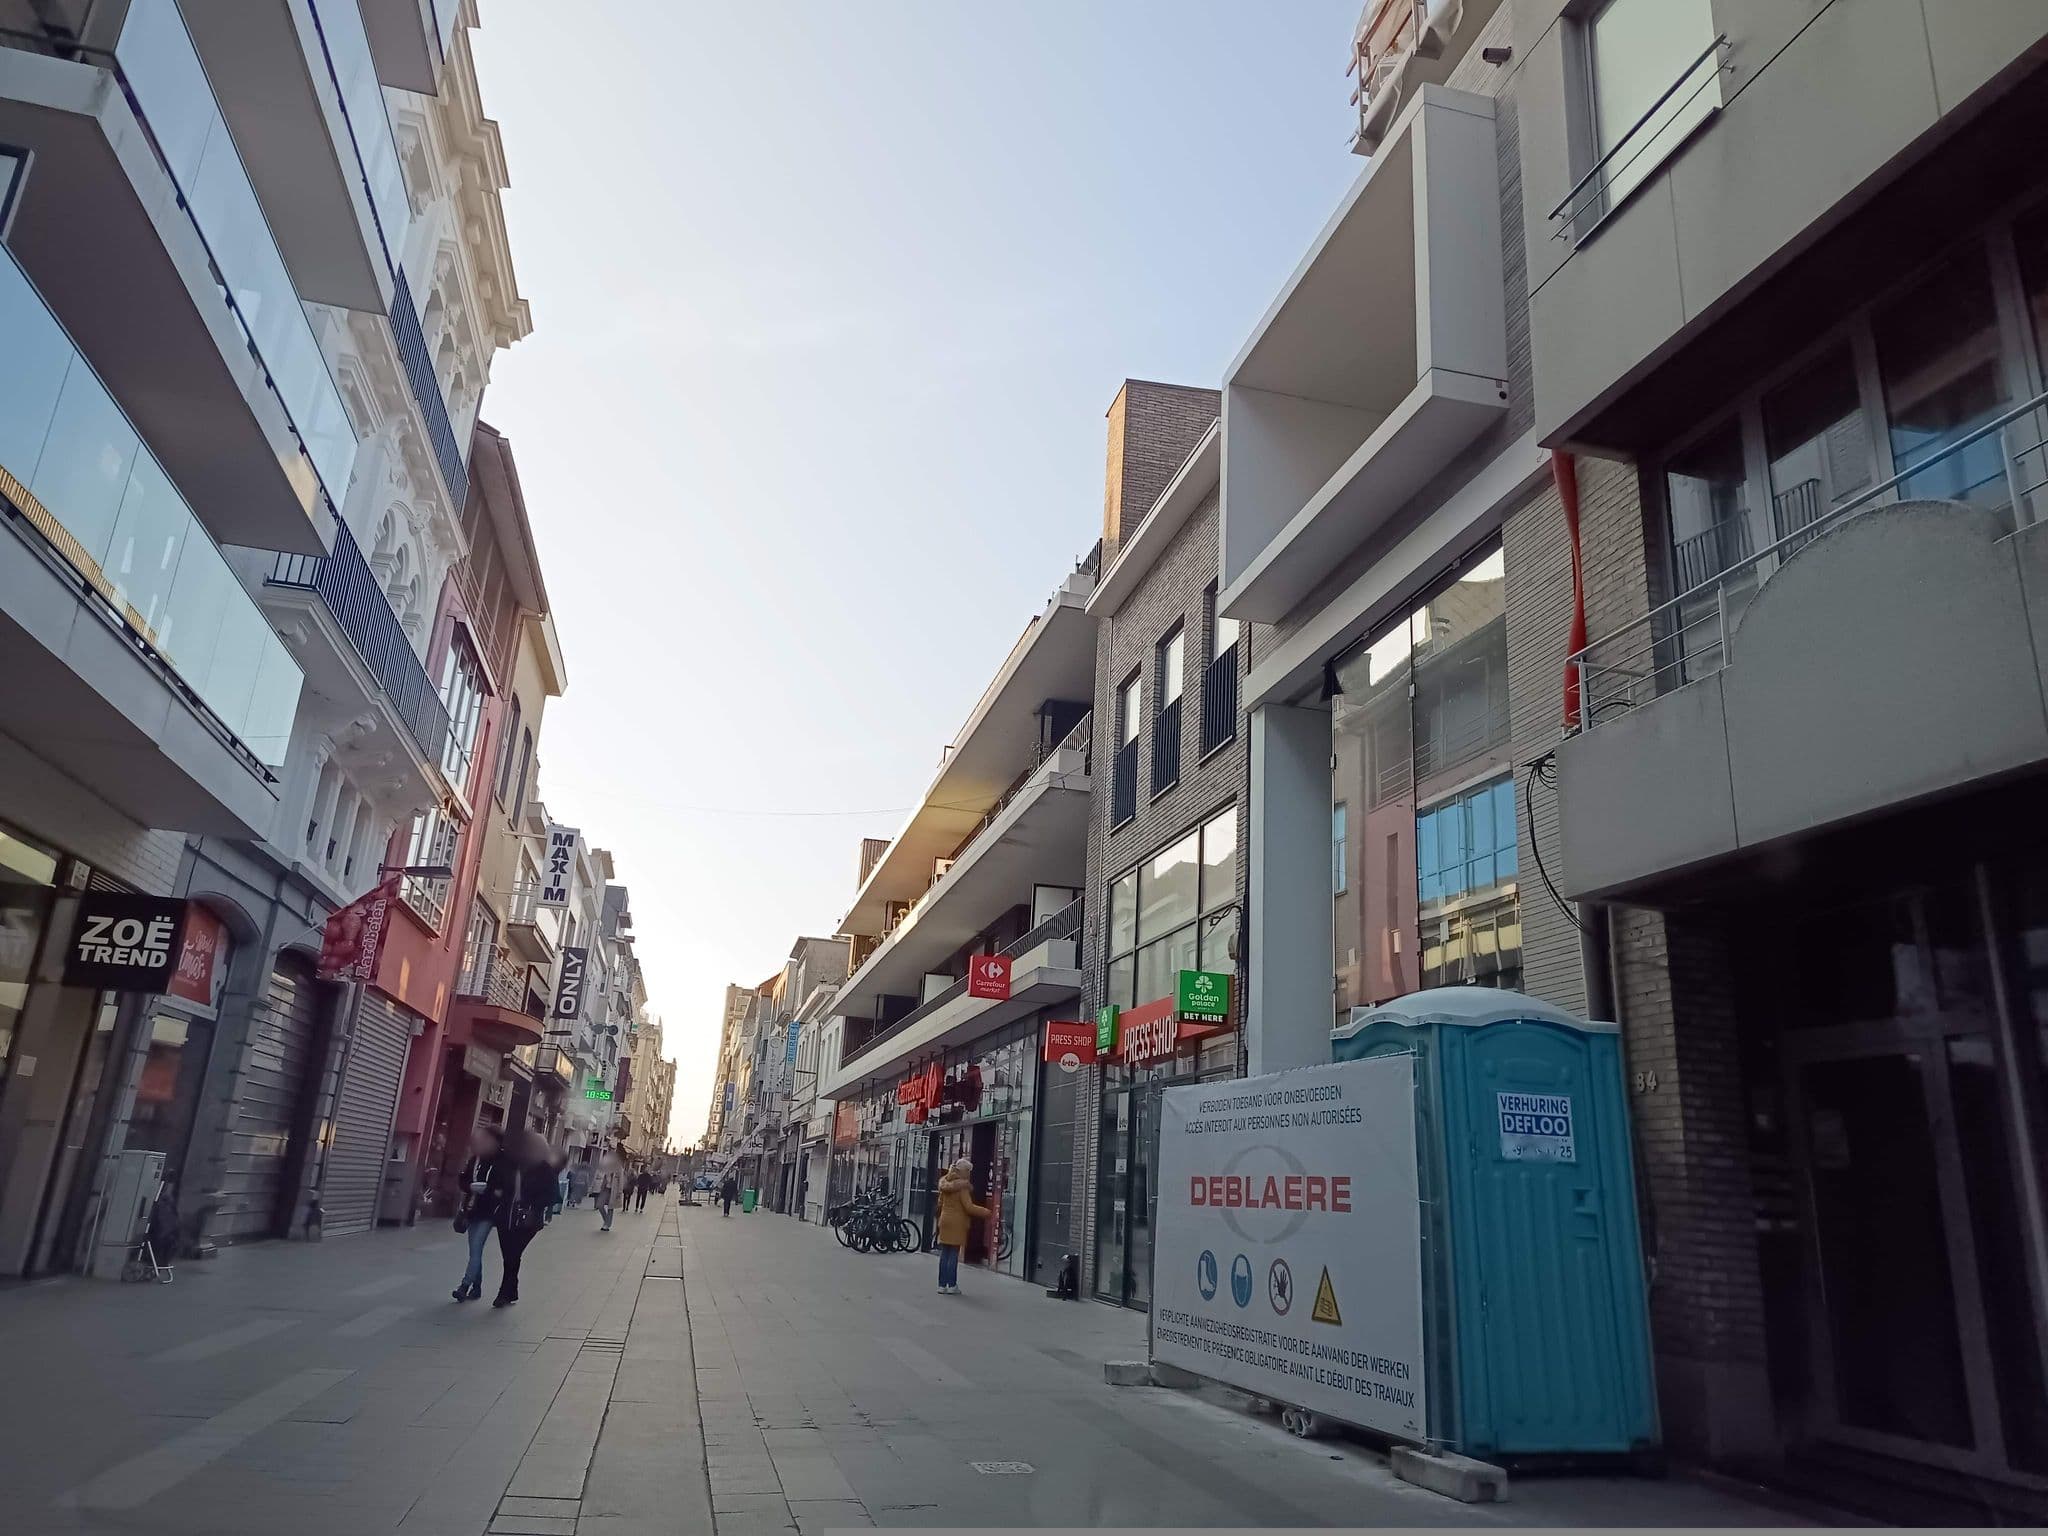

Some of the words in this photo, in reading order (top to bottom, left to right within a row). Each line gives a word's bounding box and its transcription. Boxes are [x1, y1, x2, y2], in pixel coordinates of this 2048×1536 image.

[543, 832, 574, 901] MAXIM
[80, 915, 175, 950] ZOË
[355, 899, 388, 979] Aardbeien
[78, 944, 167, 968] TREND
[559, 952, 583, 1014] ONLY
[976, 980, 1005, 988] Carrefour
[1188, 993, 1219, 1002] Golden
[1184, 1012, 1199, 1020] BET
[1201, 1014, 1223, 1023] HERE
[1050, 1034, 1072, 1045] PRESS
[1073, 1036, 1092, 1047] SHOP
[1123, 1023, 1150, 1064] PRESS
[1152, 1014, 1178, 1057] SHOP
[586, 1091, 611, 1100] 18:55
[1636, 1070, 1657, 1093] 84
[1199, 1099, 1231, 1113] VERBODEN
[1233, 1094, 1263, 1110] TOEGANG
[1263, 1091, 1283, 1107] VOOR
[1284, 1085, 1342, 1105] ONBEVOEGDEN
[1500, 1095, 1569, 1115] VERHURING
[1204, 1118, 1233, 1133] INTERDIT
[1233, 1116, 1247, 1131] AUX
[1248, 1113, 1290, 1131] PERSONNES
[1291, 1112, 1309, 1127] NON
[1310, 1105, 1362, 1127] AUTORISÉES
[1503, 1116, 1568, 1135] DEFLOO
[1190, 1175, 1352, 1213] DEBLAERE
[1160, 1309, 1190, 1327] VERPLICHTE
[1190, 1315, 1278, 1348] AANWEZIGHEIDSREGISTRATIE
[1278, 1336, 1298, 1353] VOOR
[1299, 1340, 1310, 1356] DE
[1311, 1343, 1349, 1365] AANVANG
[1351, 1352, 1369, 1370] DER
[1370, 1356, 1410, 1380] WERKEN
[1157, 1327, 1202, 1351] ENREGISTREMENT
[1203, 1339, 1212, 1354] DE
[1244, 1350, 1288, 1374] OBLIGATOIRE
[1289, 1362, 1314, 1381] AVANT
[1315, 1367, 1325, 1384] LE
[1326, 1369, 1353, 1392] DÉBUT
[1355, 1378, 1372, 1396] DES
[1373, 1382, 1415, 1408] TRAVAUX
